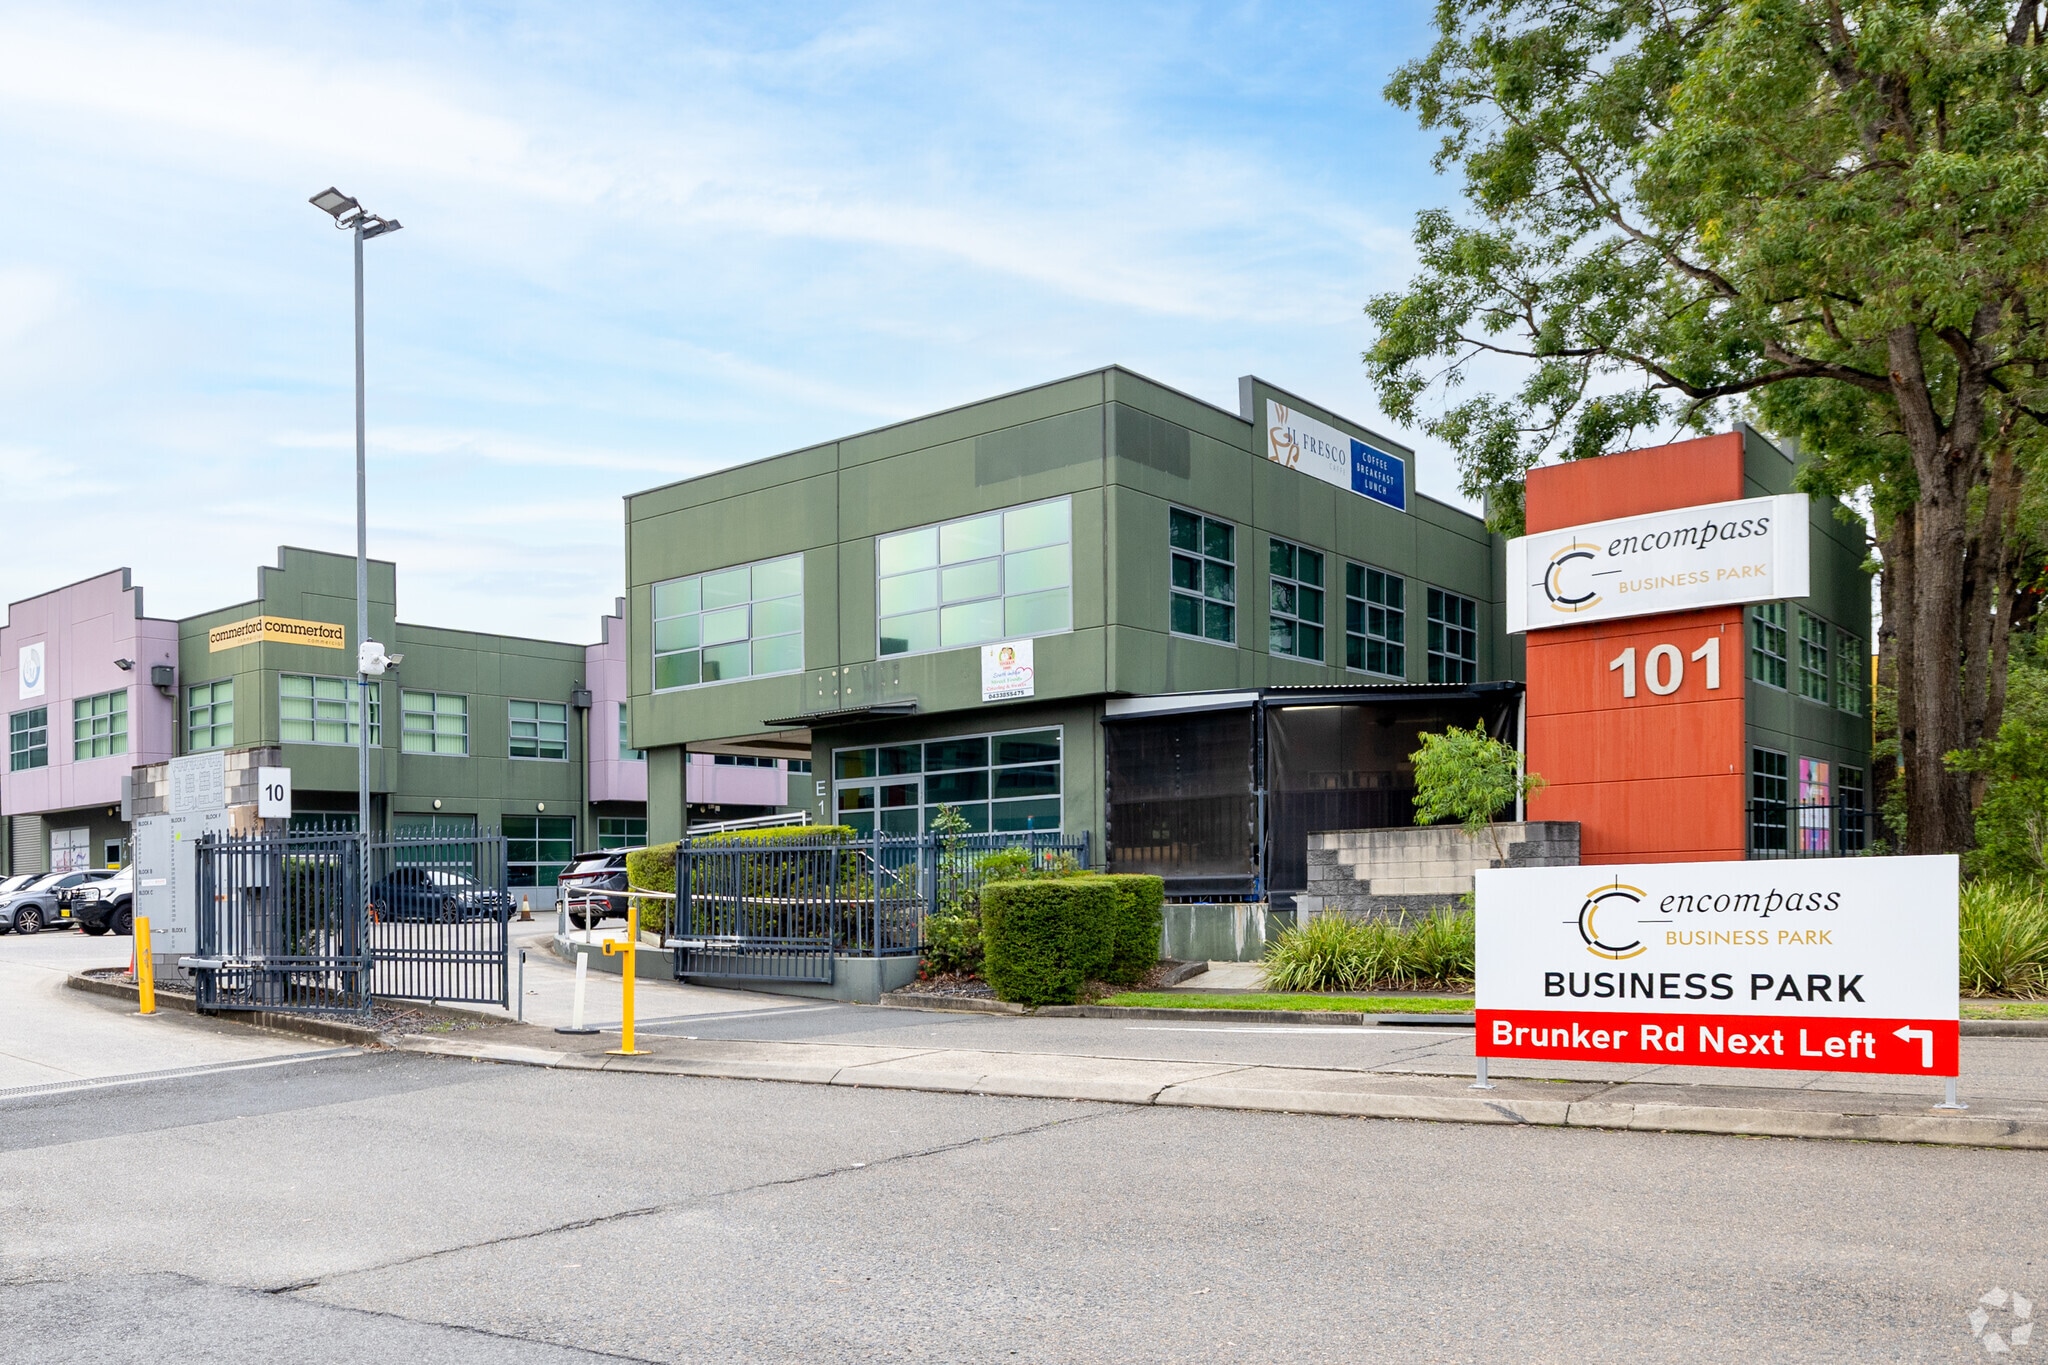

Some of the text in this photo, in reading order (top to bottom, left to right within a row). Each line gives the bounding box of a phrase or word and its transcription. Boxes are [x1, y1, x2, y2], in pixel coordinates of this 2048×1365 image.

[1287, 427, 1346, 466] IL FRESCO
[1356, 462, 1394, 486] BREAKFAST
[1362, 452, 1388, 471] COFFEE
[1364, 479, 1387, 496] LUNCH
[1608, 516, 1770, 557] encompass
[1618, 563, 1767, 594] BUSINESS PARK
[210, 618, 262, 644] commerford
[264, 621, 343, 639] commerford
[307, 638, 343, 646] commercial
[1609, 637, 1720, 698] 101
[265, 783, 284, 801] 10
[1659, 888, 1841, 918] encompass
[1665, 930, 1833, 946] BUSINESS PARK
[1544, 971, 1866, 1003] BUSINESS PARK
[1492, 1020, 1876, 1059] Brunker Rd Next Left
